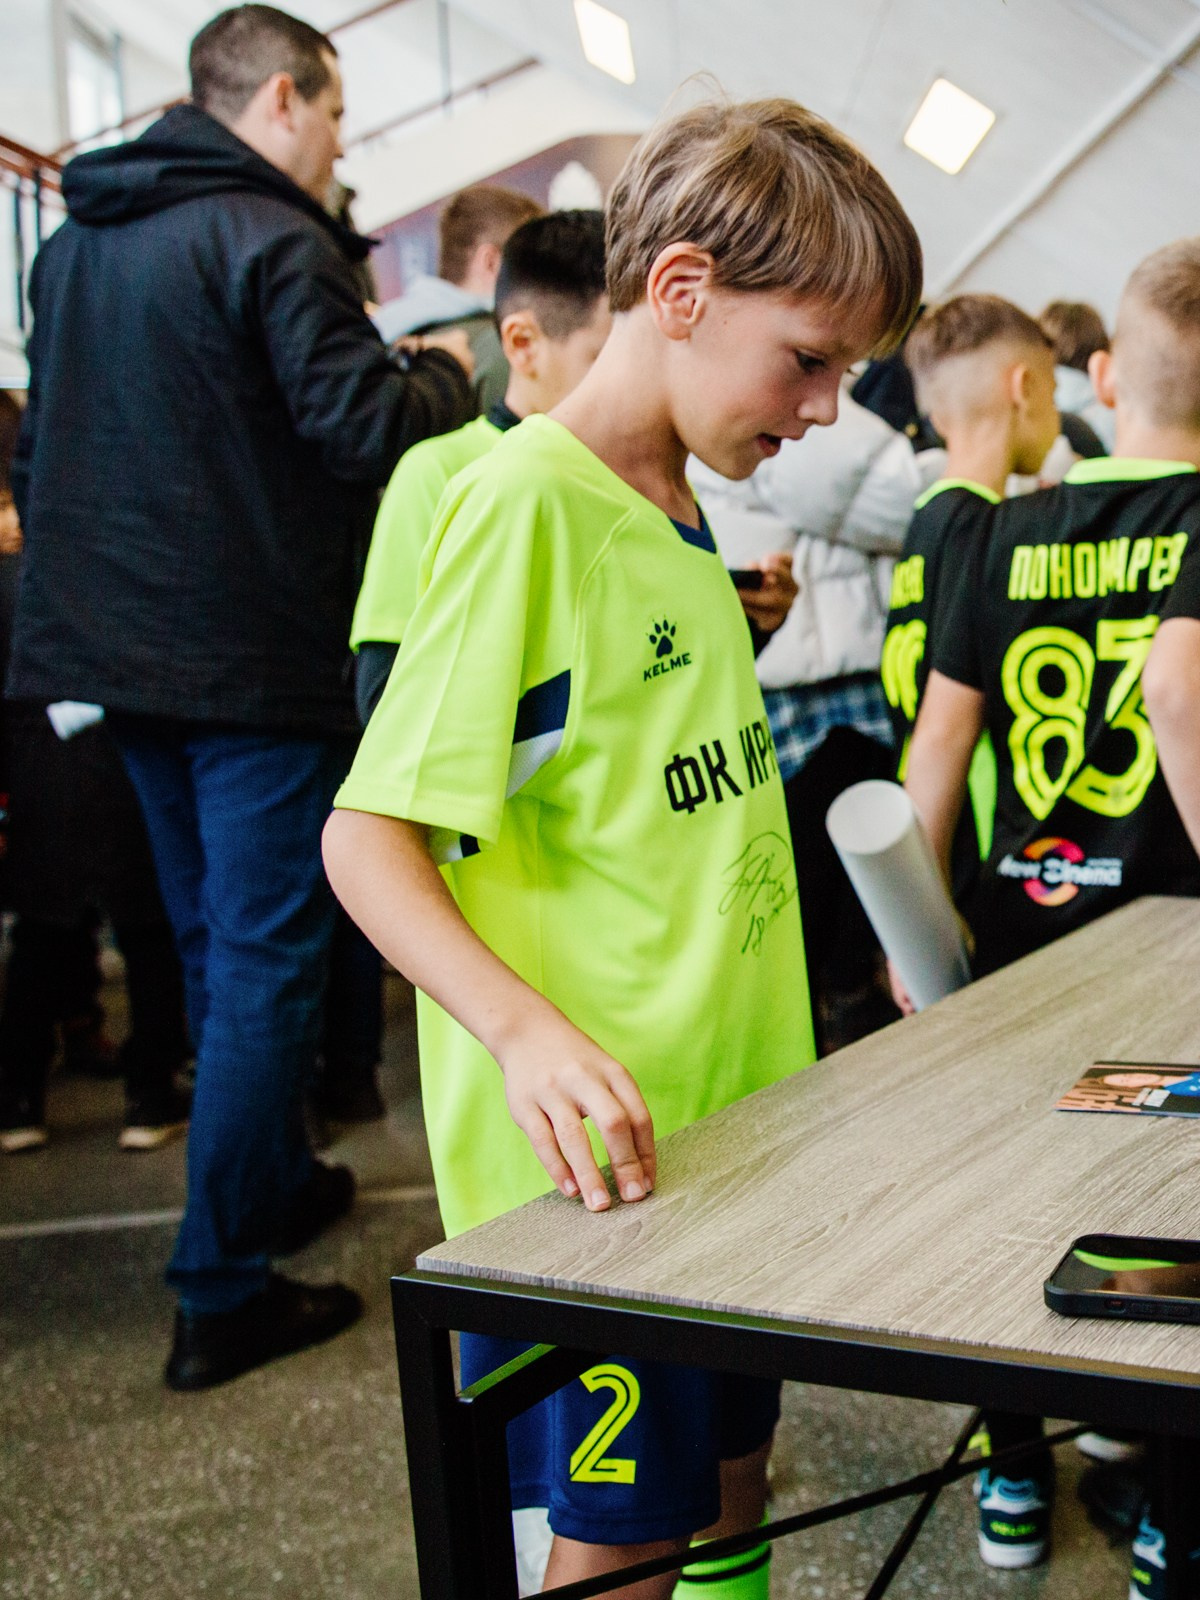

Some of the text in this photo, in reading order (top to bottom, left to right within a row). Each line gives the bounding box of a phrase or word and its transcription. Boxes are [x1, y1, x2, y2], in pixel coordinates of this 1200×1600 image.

[643, 652, 692, 682] KELME
[1002, 615, 1159, 820] 83
[664, 716, 776, 814] ФК ИР
[569, 1363, 640, 1484] 2
